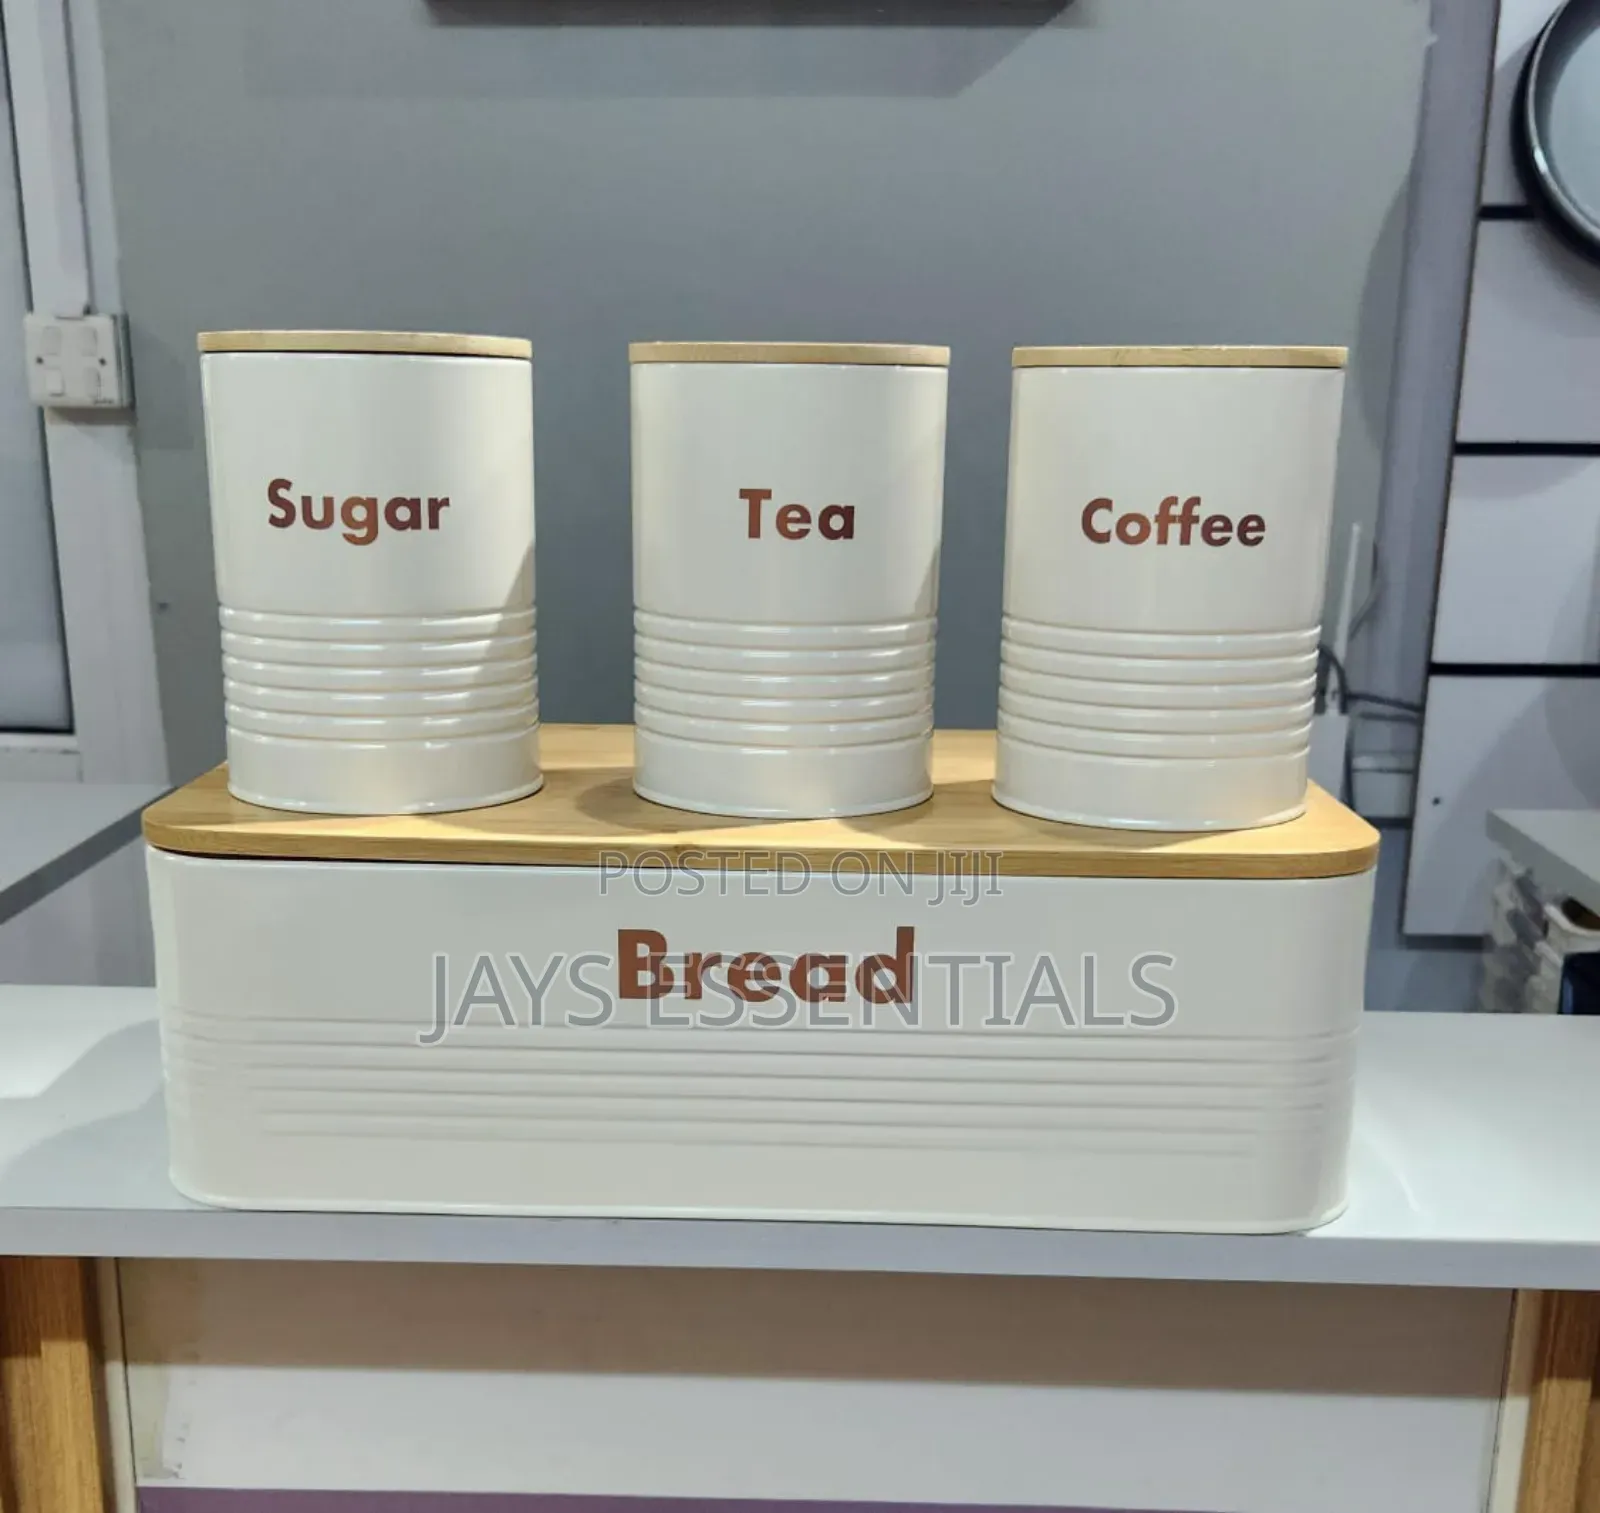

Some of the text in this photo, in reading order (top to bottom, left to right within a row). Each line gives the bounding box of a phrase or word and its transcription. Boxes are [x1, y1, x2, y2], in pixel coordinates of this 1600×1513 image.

[267, 479, 450, 547] Sugar
[739, 488, 856, 541] Tea
[1081, 495, 1266, 548] Coffee
[617, 926, 916, 1005] Bread
